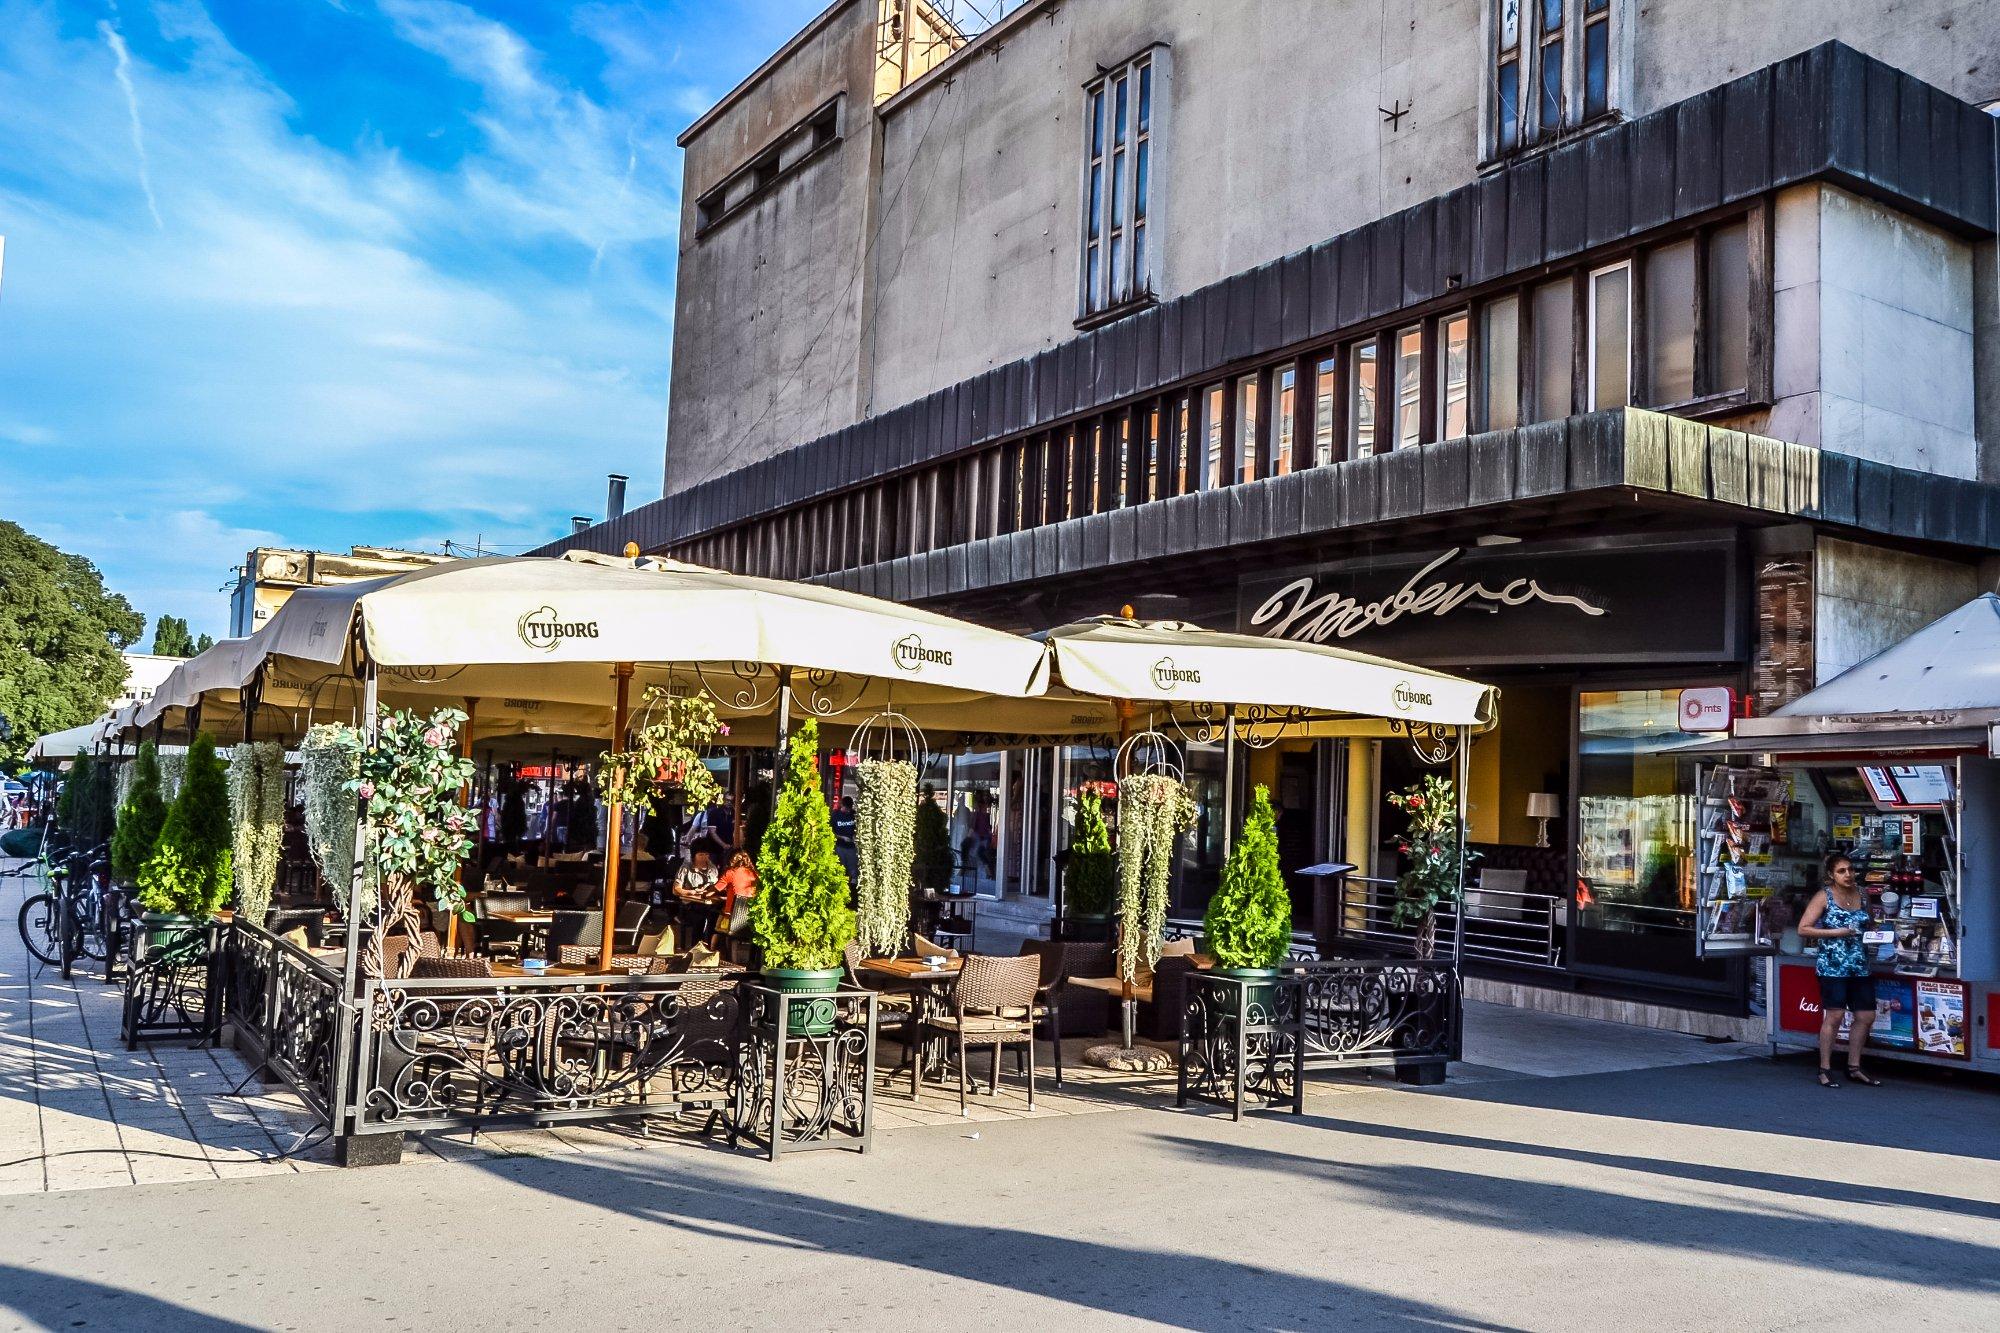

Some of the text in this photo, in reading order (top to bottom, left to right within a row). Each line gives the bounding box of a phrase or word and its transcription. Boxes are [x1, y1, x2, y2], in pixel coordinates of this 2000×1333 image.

[527, 621, 599, 640] TUBORG
[899, 643, 952, 666] TUBORG
[1156, 667, 1201, 684] TUBORG
[1395, 688, 1433, 706] TUBORG
[1704, 705, 1722, 713] mts
